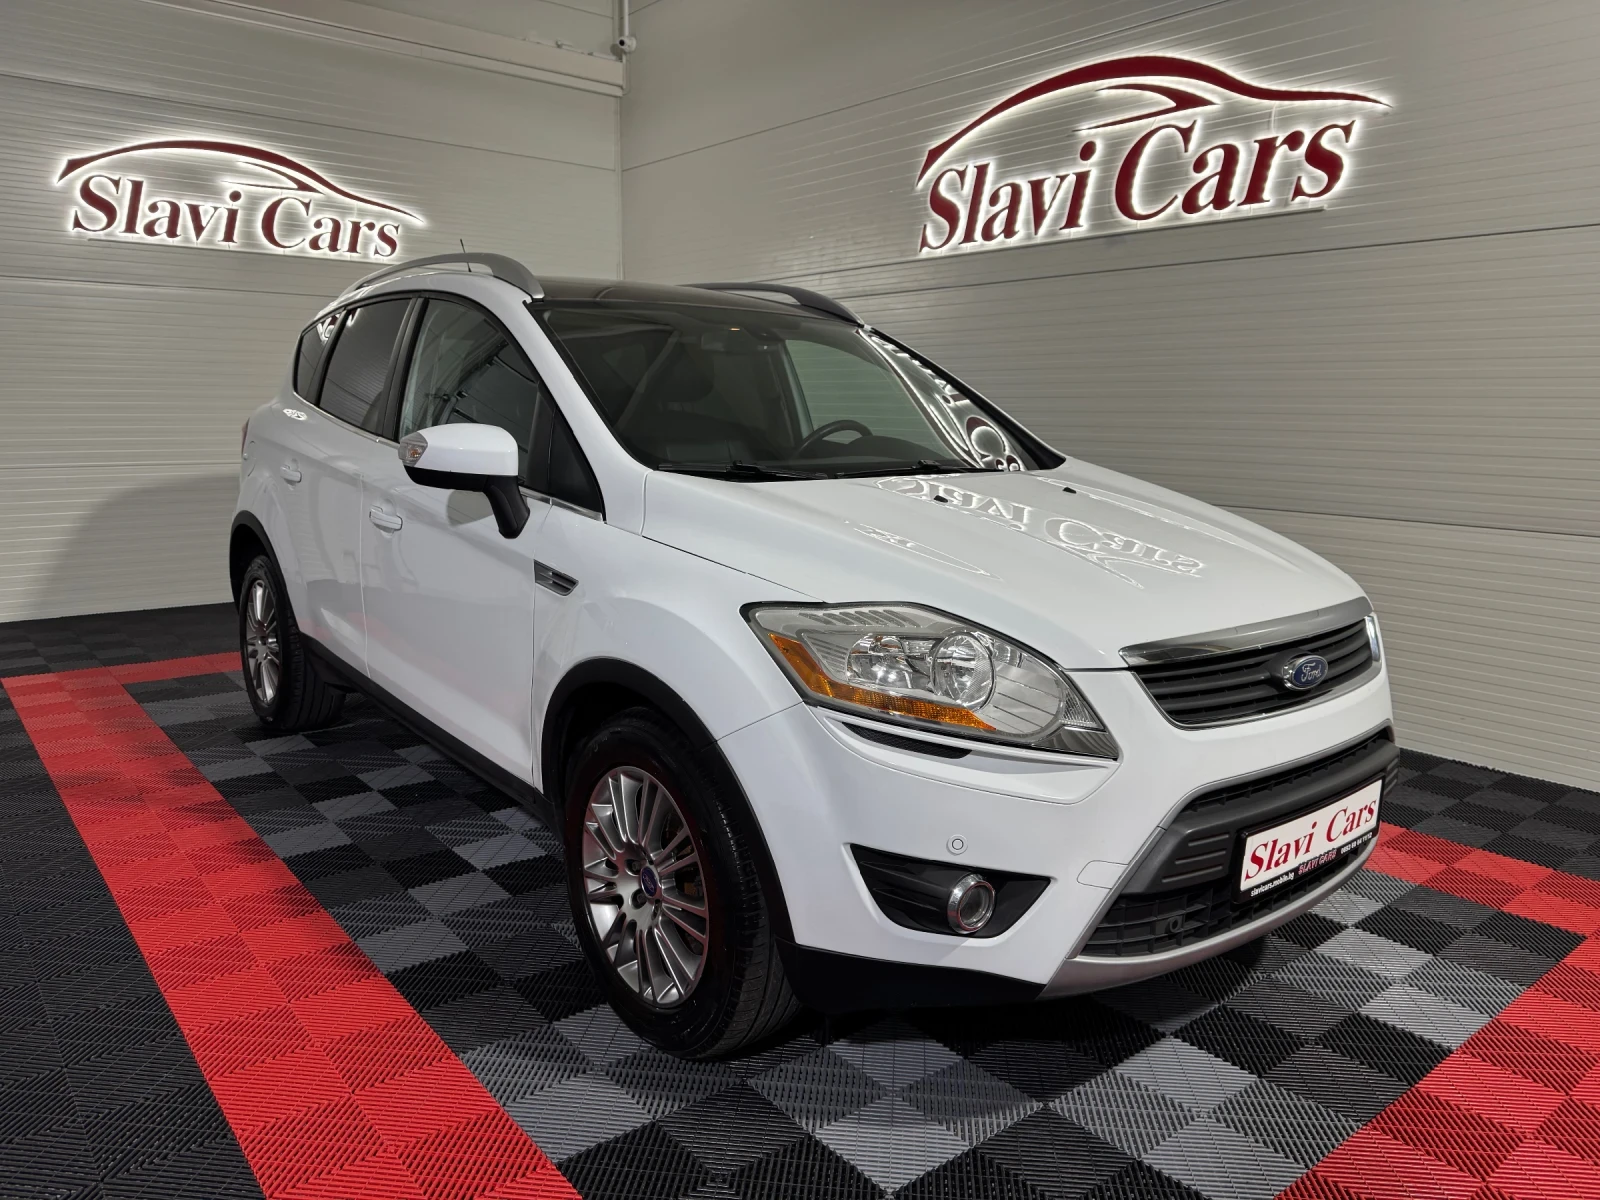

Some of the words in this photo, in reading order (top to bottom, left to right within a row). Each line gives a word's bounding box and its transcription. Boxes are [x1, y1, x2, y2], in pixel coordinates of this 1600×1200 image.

[918, 140, 1098, 253] Slavi
[1114, 120, 1356, 221] Cars
[72, 174, 242, 244] Slavi
[261, 196, 401, 257] Cars
[1301, 662, 1322, 682] Ford
[1244, 821, 1318, 882] Slavi
[1326, 799, 1377, 843] Cars
[1298, 857, 1319, 876] SLAVI
[1319, 848, 1337, 866] CARS
[1250, 871, 1295, 897] slavicars.mobile.bg
